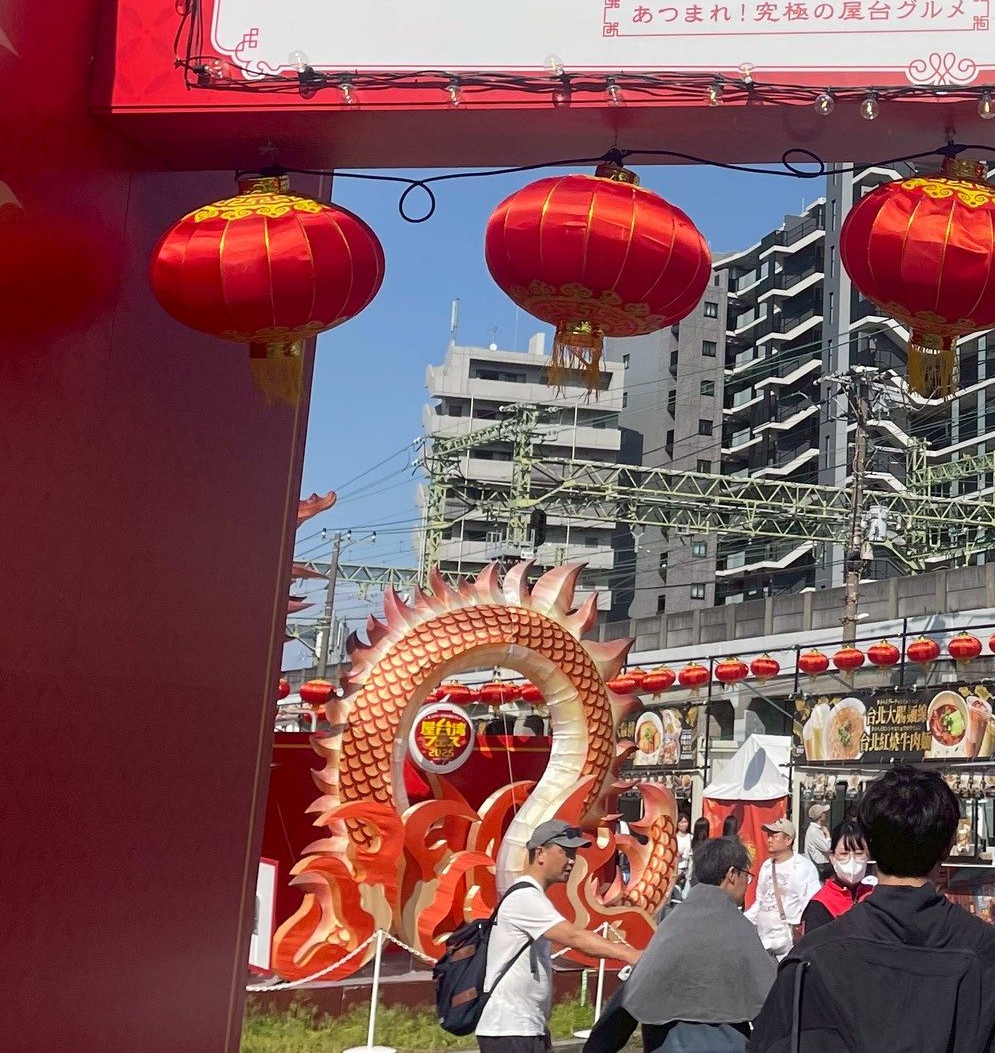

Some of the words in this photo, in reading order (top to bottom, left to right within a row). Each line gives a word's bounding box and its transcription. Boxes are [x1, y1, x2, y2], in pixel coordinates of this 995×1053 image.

[420, 718, 466, 737] 屋台湾
[424, 736, 460, 747] フェス
[429, 748, 455, 757] 2025
